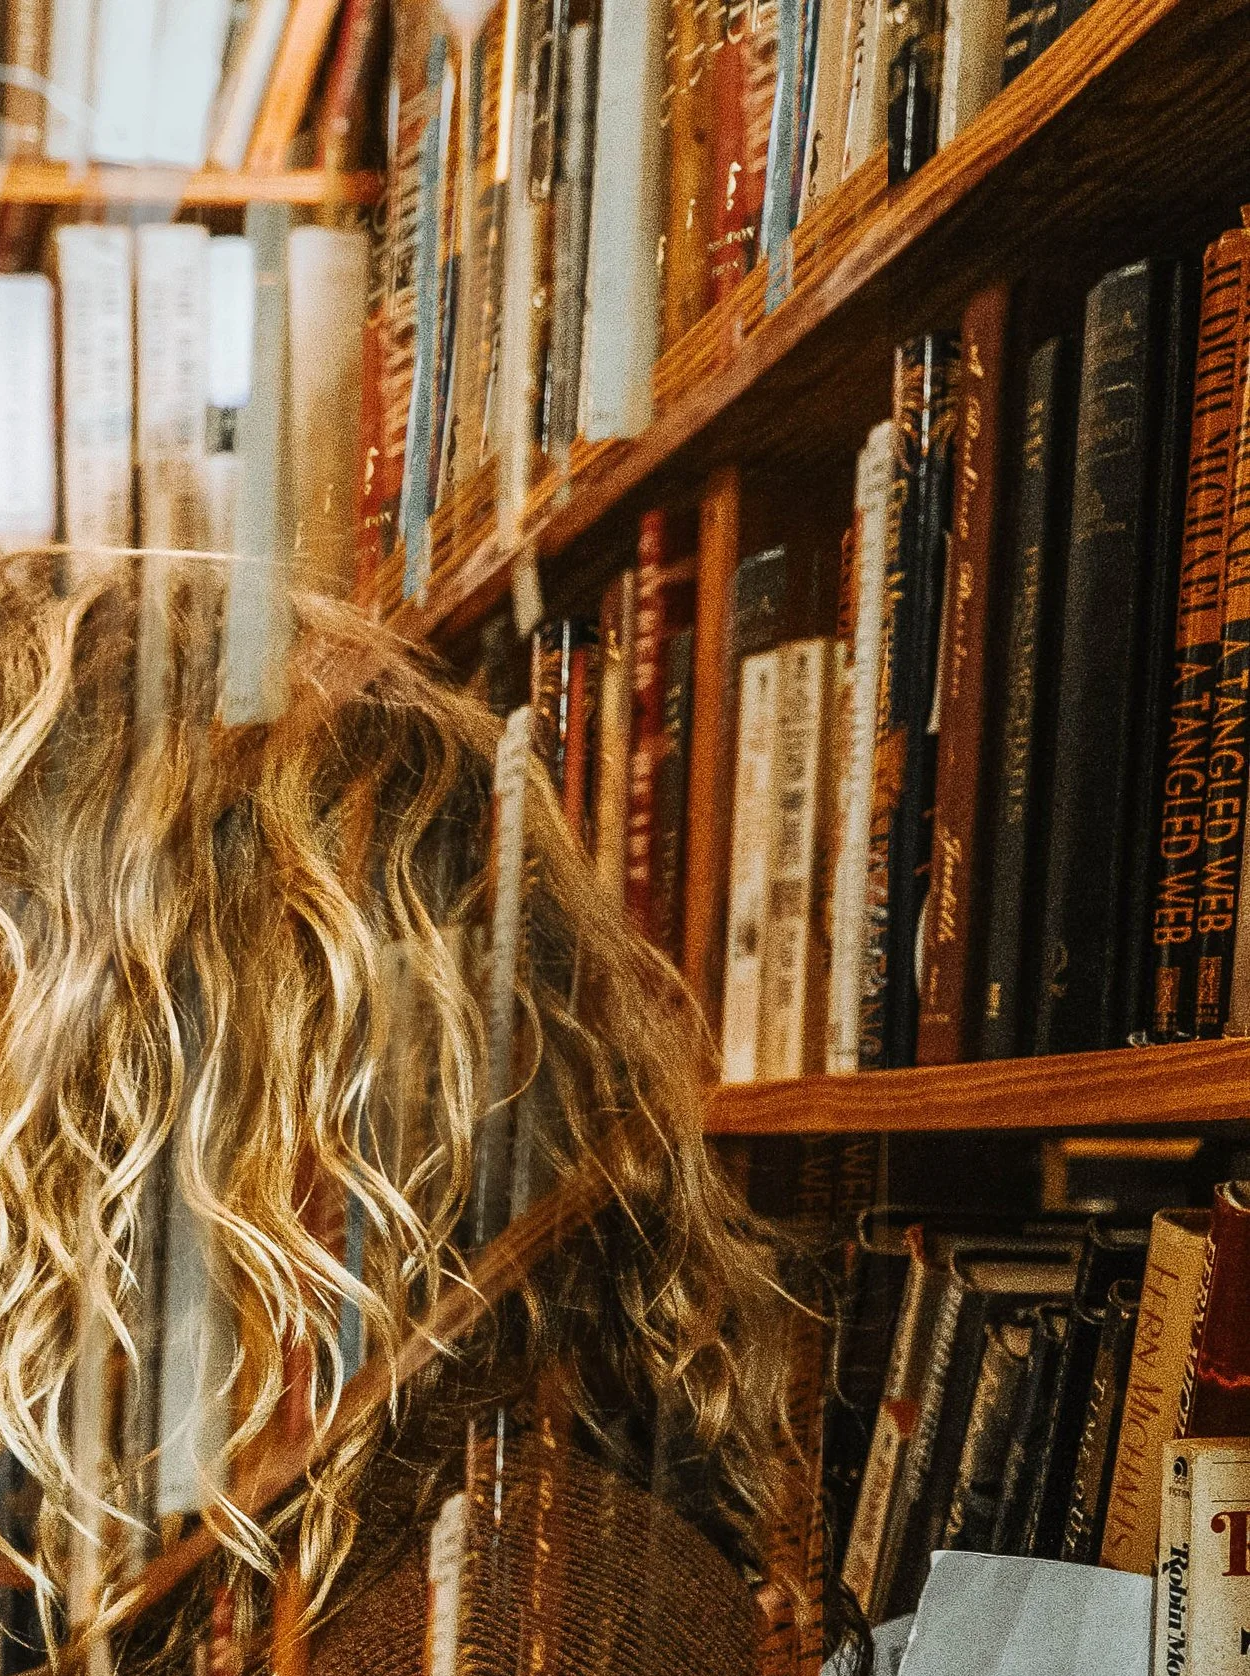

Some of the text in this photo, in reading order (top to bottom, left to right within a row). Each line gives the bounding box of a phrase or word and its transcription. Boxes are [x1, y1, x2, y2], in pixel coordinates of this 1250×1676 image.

[1197, 258, 1242, 417] JUDITH
[1180, 428, 1232, 634] MICHAEL
[1173, 662, 1213, 688] A
[1160, 690, 1212, 860] TANGLED
[1201, 668, 1250, 845] TANGLED
[1152, 868, 1197, 945] WEB
[1196, 855, 1237, 934] WEB
[1161, 1542, 1190, 1633] Robin
